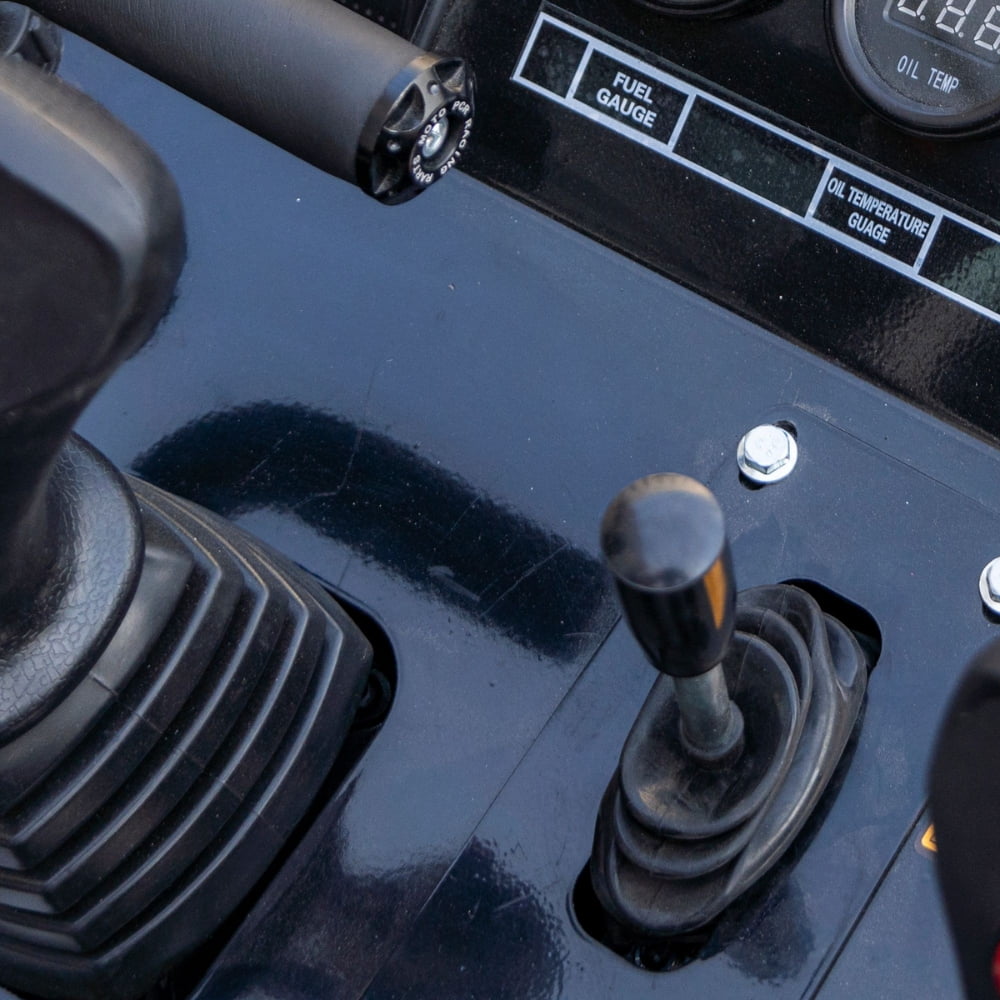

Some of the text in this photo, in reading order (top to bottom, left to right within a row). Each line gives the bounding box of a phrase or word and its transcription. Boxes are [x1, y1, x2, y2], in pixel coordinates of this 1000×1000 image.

[612, 71, 653, 104] FUEL
[897, 55, 960, 94] OIL TEMP
[418, 107, 447, 145] MOTO
[596, 87, 657, 128] GAUGE
[827, 177, 930, 238] OIL TEMPERATURE
[848, 212, 891, 244] GUAGE
